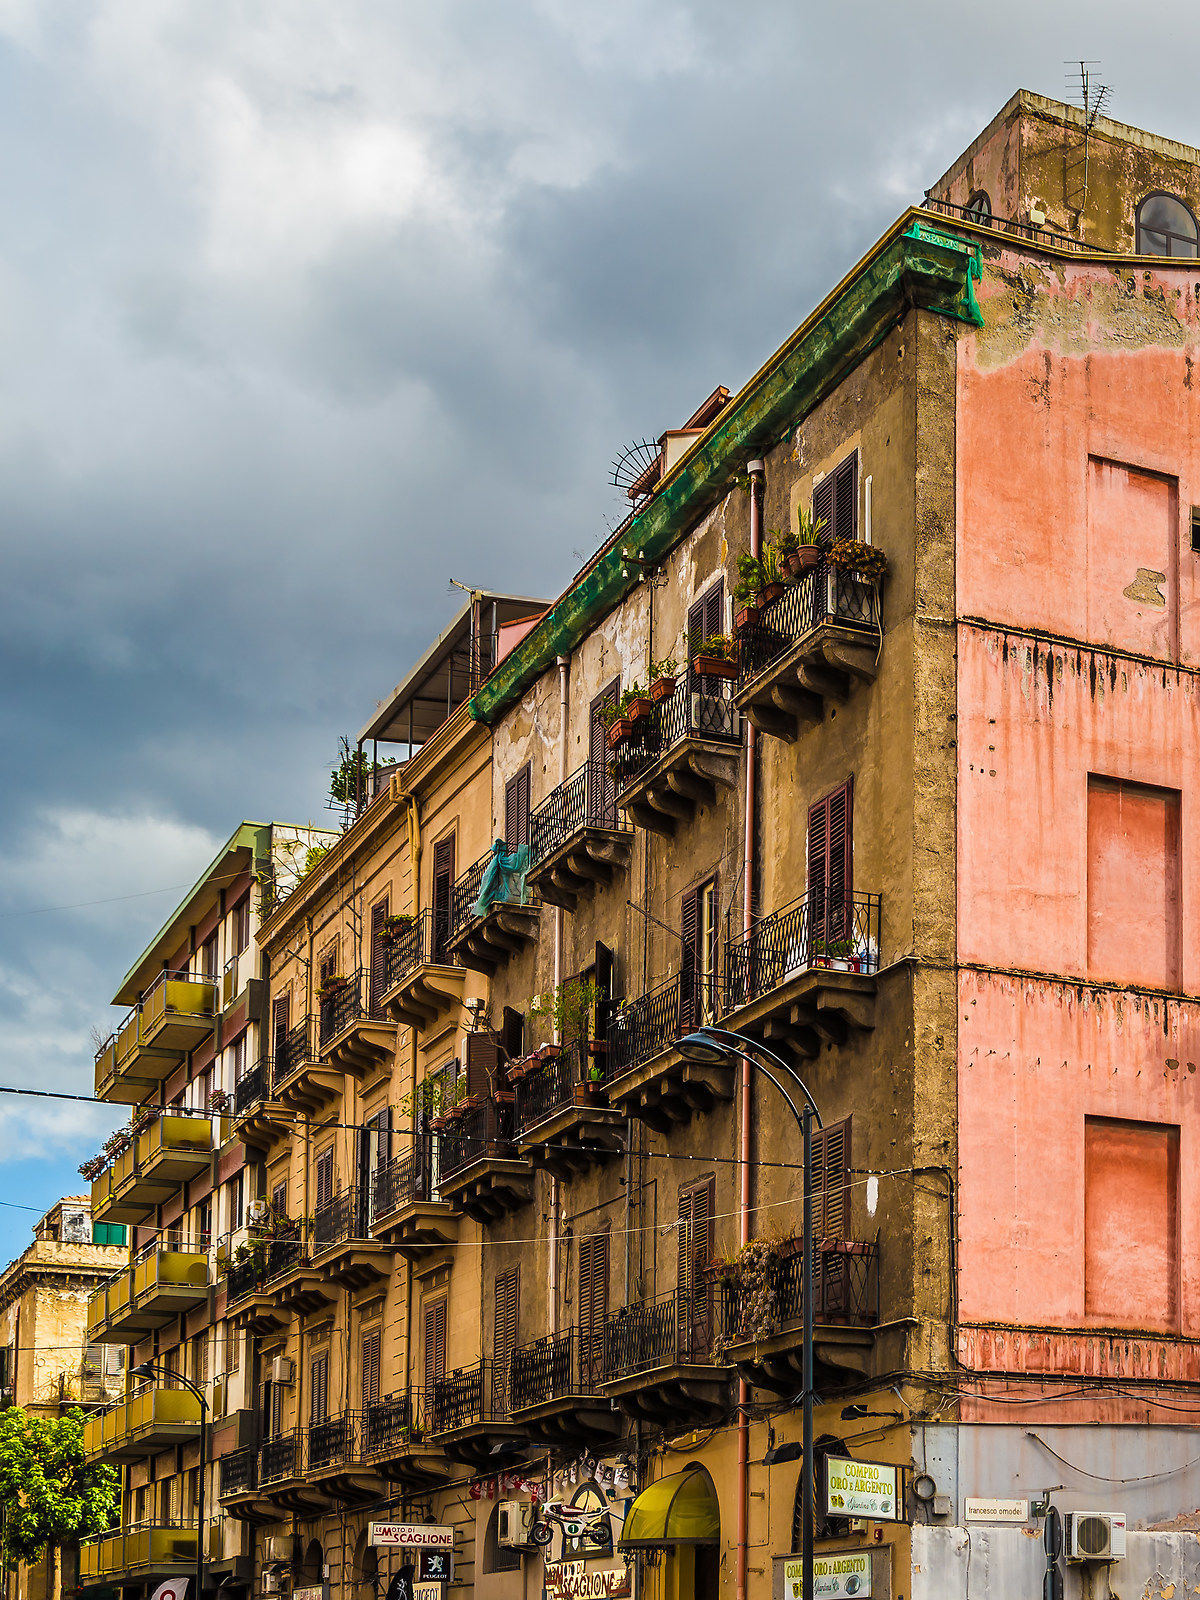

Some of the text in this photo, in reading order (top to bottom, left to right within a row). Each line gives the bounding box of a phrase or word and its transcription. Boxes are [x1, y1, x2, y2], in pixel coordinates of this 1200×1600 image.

[844, 1464, 879, 1480] COMPRO
[830, 1476, 893, 1496] ORO E ARGENTO
[968, 1507, 997, 1515] francesco
[393, 1533, 453, 1544] SCAGLIONE
[787, 1564, 803, 1578] COM
[814, 1562, 828, 1575] ORO
[832, 1558, 866, 1575] ARGENTO
[561, 1572, 616, 1598] SCAGLIONE
